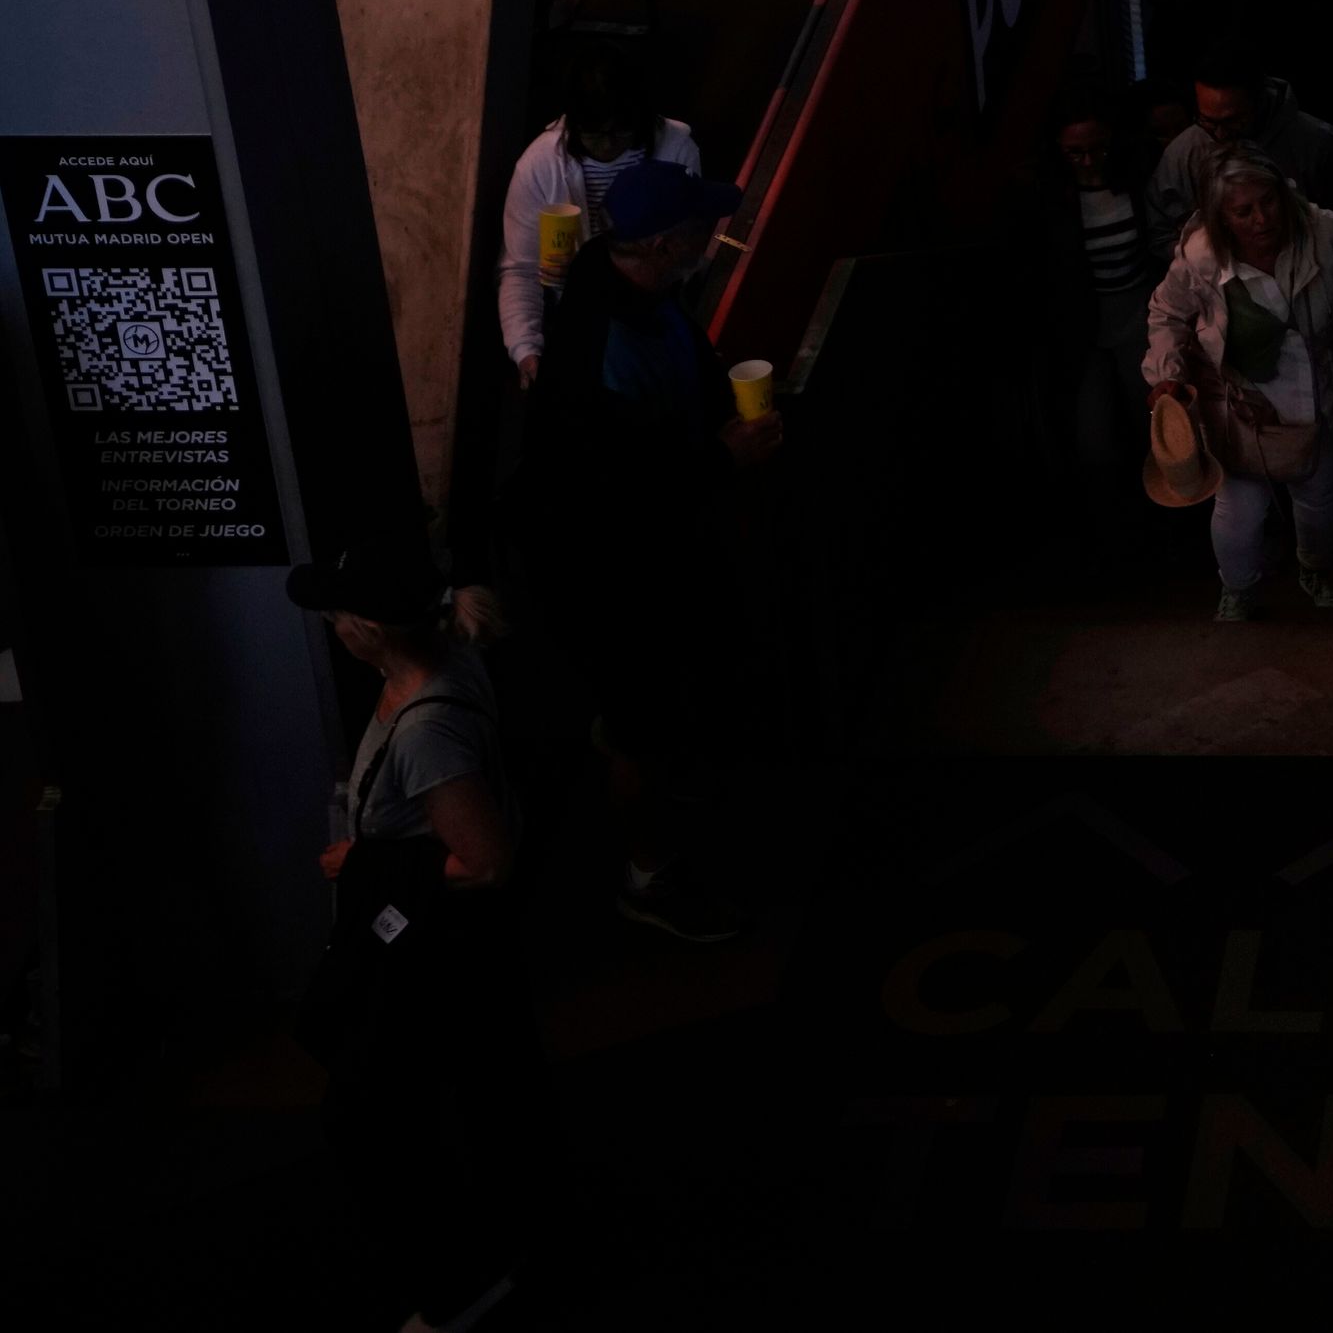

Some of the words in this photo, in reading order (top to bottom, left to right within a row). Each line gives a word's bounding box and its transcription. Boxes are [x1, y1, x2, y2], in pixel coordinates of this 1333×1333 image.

[58, 156, 115, 167] ACCEDE
[118, 153, 155, 167] AQUÍ
[32, 172, 201, 223] ABC
[28, 232, 90, 245] MUTUA
[94, 232, 162, 245] MADRID
[166, 232, 215, 245] OPEN
[93, 430, 132, 445] LAS
[136, 430, 228, 445] MEJORES
[100, 449, 230, 464] ENTREVISTAS
[101, 475, 241, 493] INFORMACIÓN
[112, 498, 150, 512] DEL
[154, 498, 237, 512] TORNEO
[94, 524, 164, 538] ORDEN
[167, 524, 196, 538] DE
[199, 523, 267, 538] JUEGO
